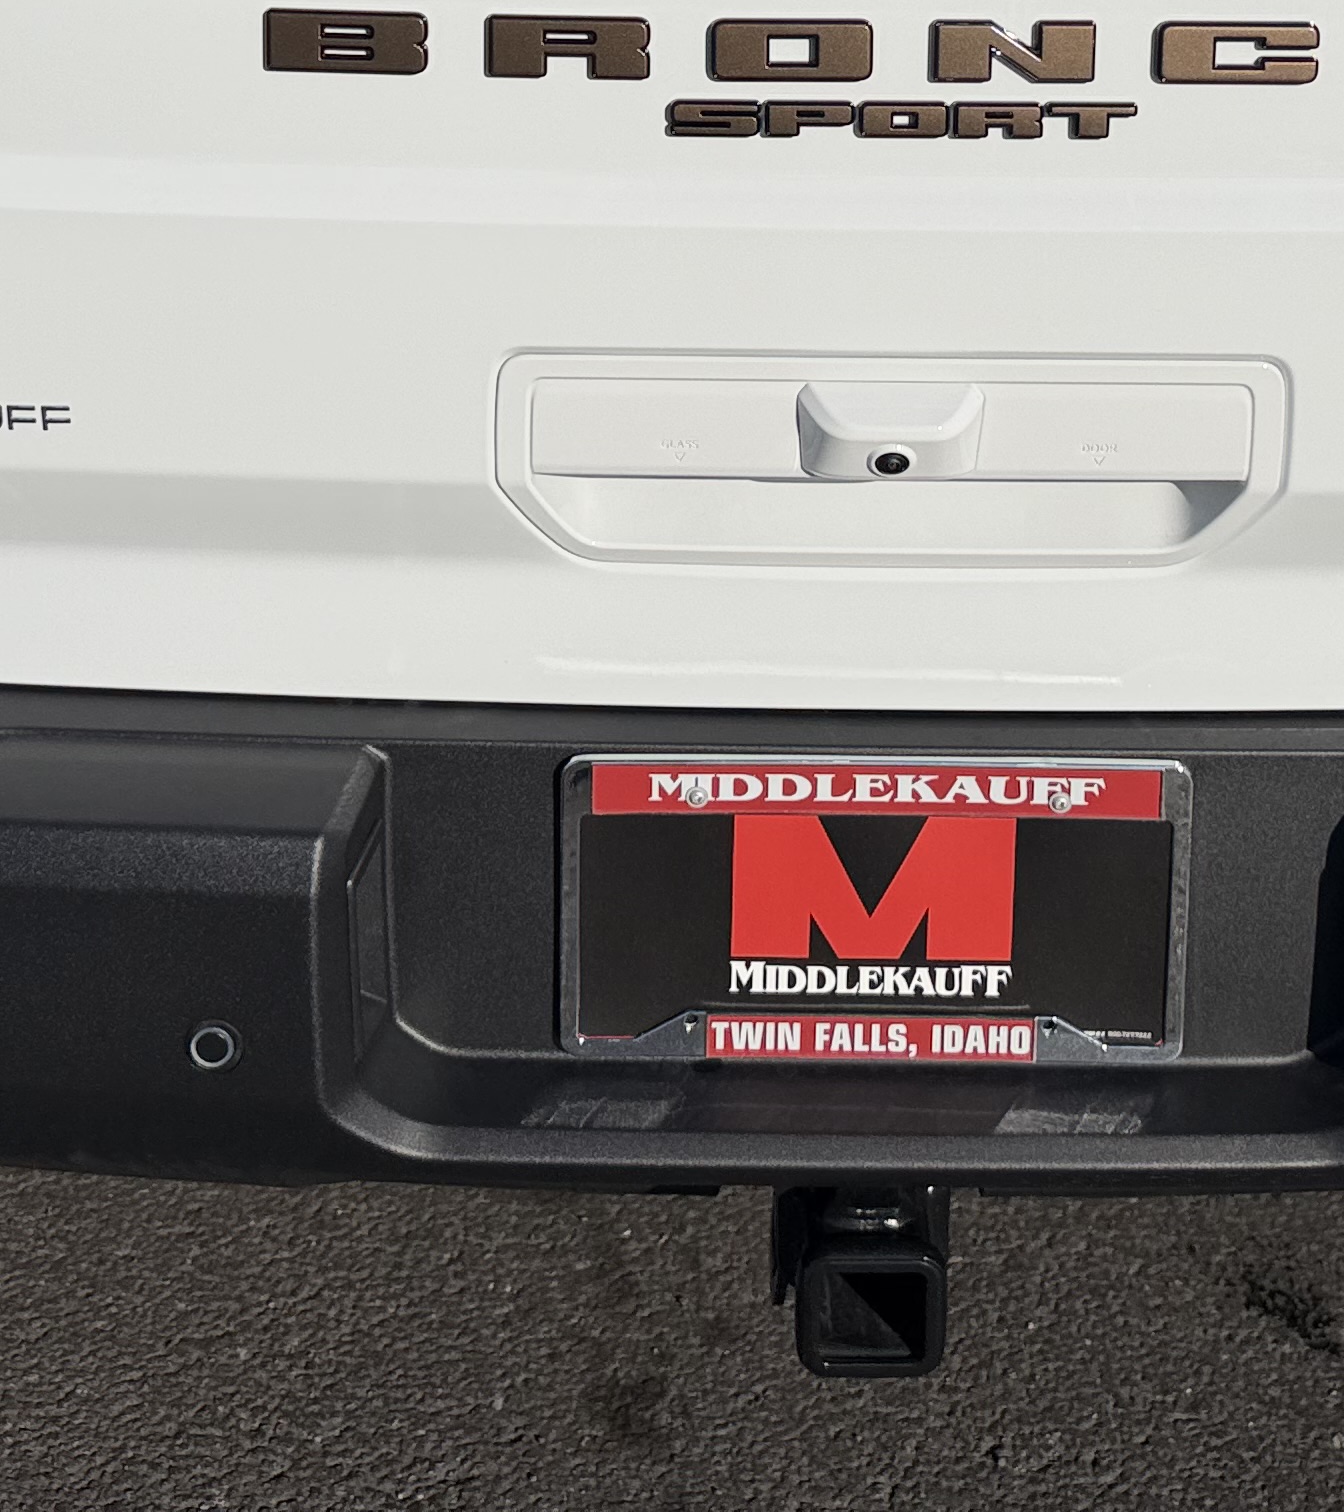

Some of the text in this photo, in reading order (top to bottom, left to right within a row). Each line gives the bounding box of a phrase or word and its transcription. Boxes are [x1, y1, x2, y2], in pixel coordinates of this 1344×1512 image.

[664, 98, 1138, 139] SPORT
[647, 772, 1107, 807] MIDDLEKAUFF
[729, 814, 1018, 961] M
[728, 959, 1013, 998] MIDDLEKAUFF
[711, 1020, 1032, 1059] TWIN FALLS, IDAHO
